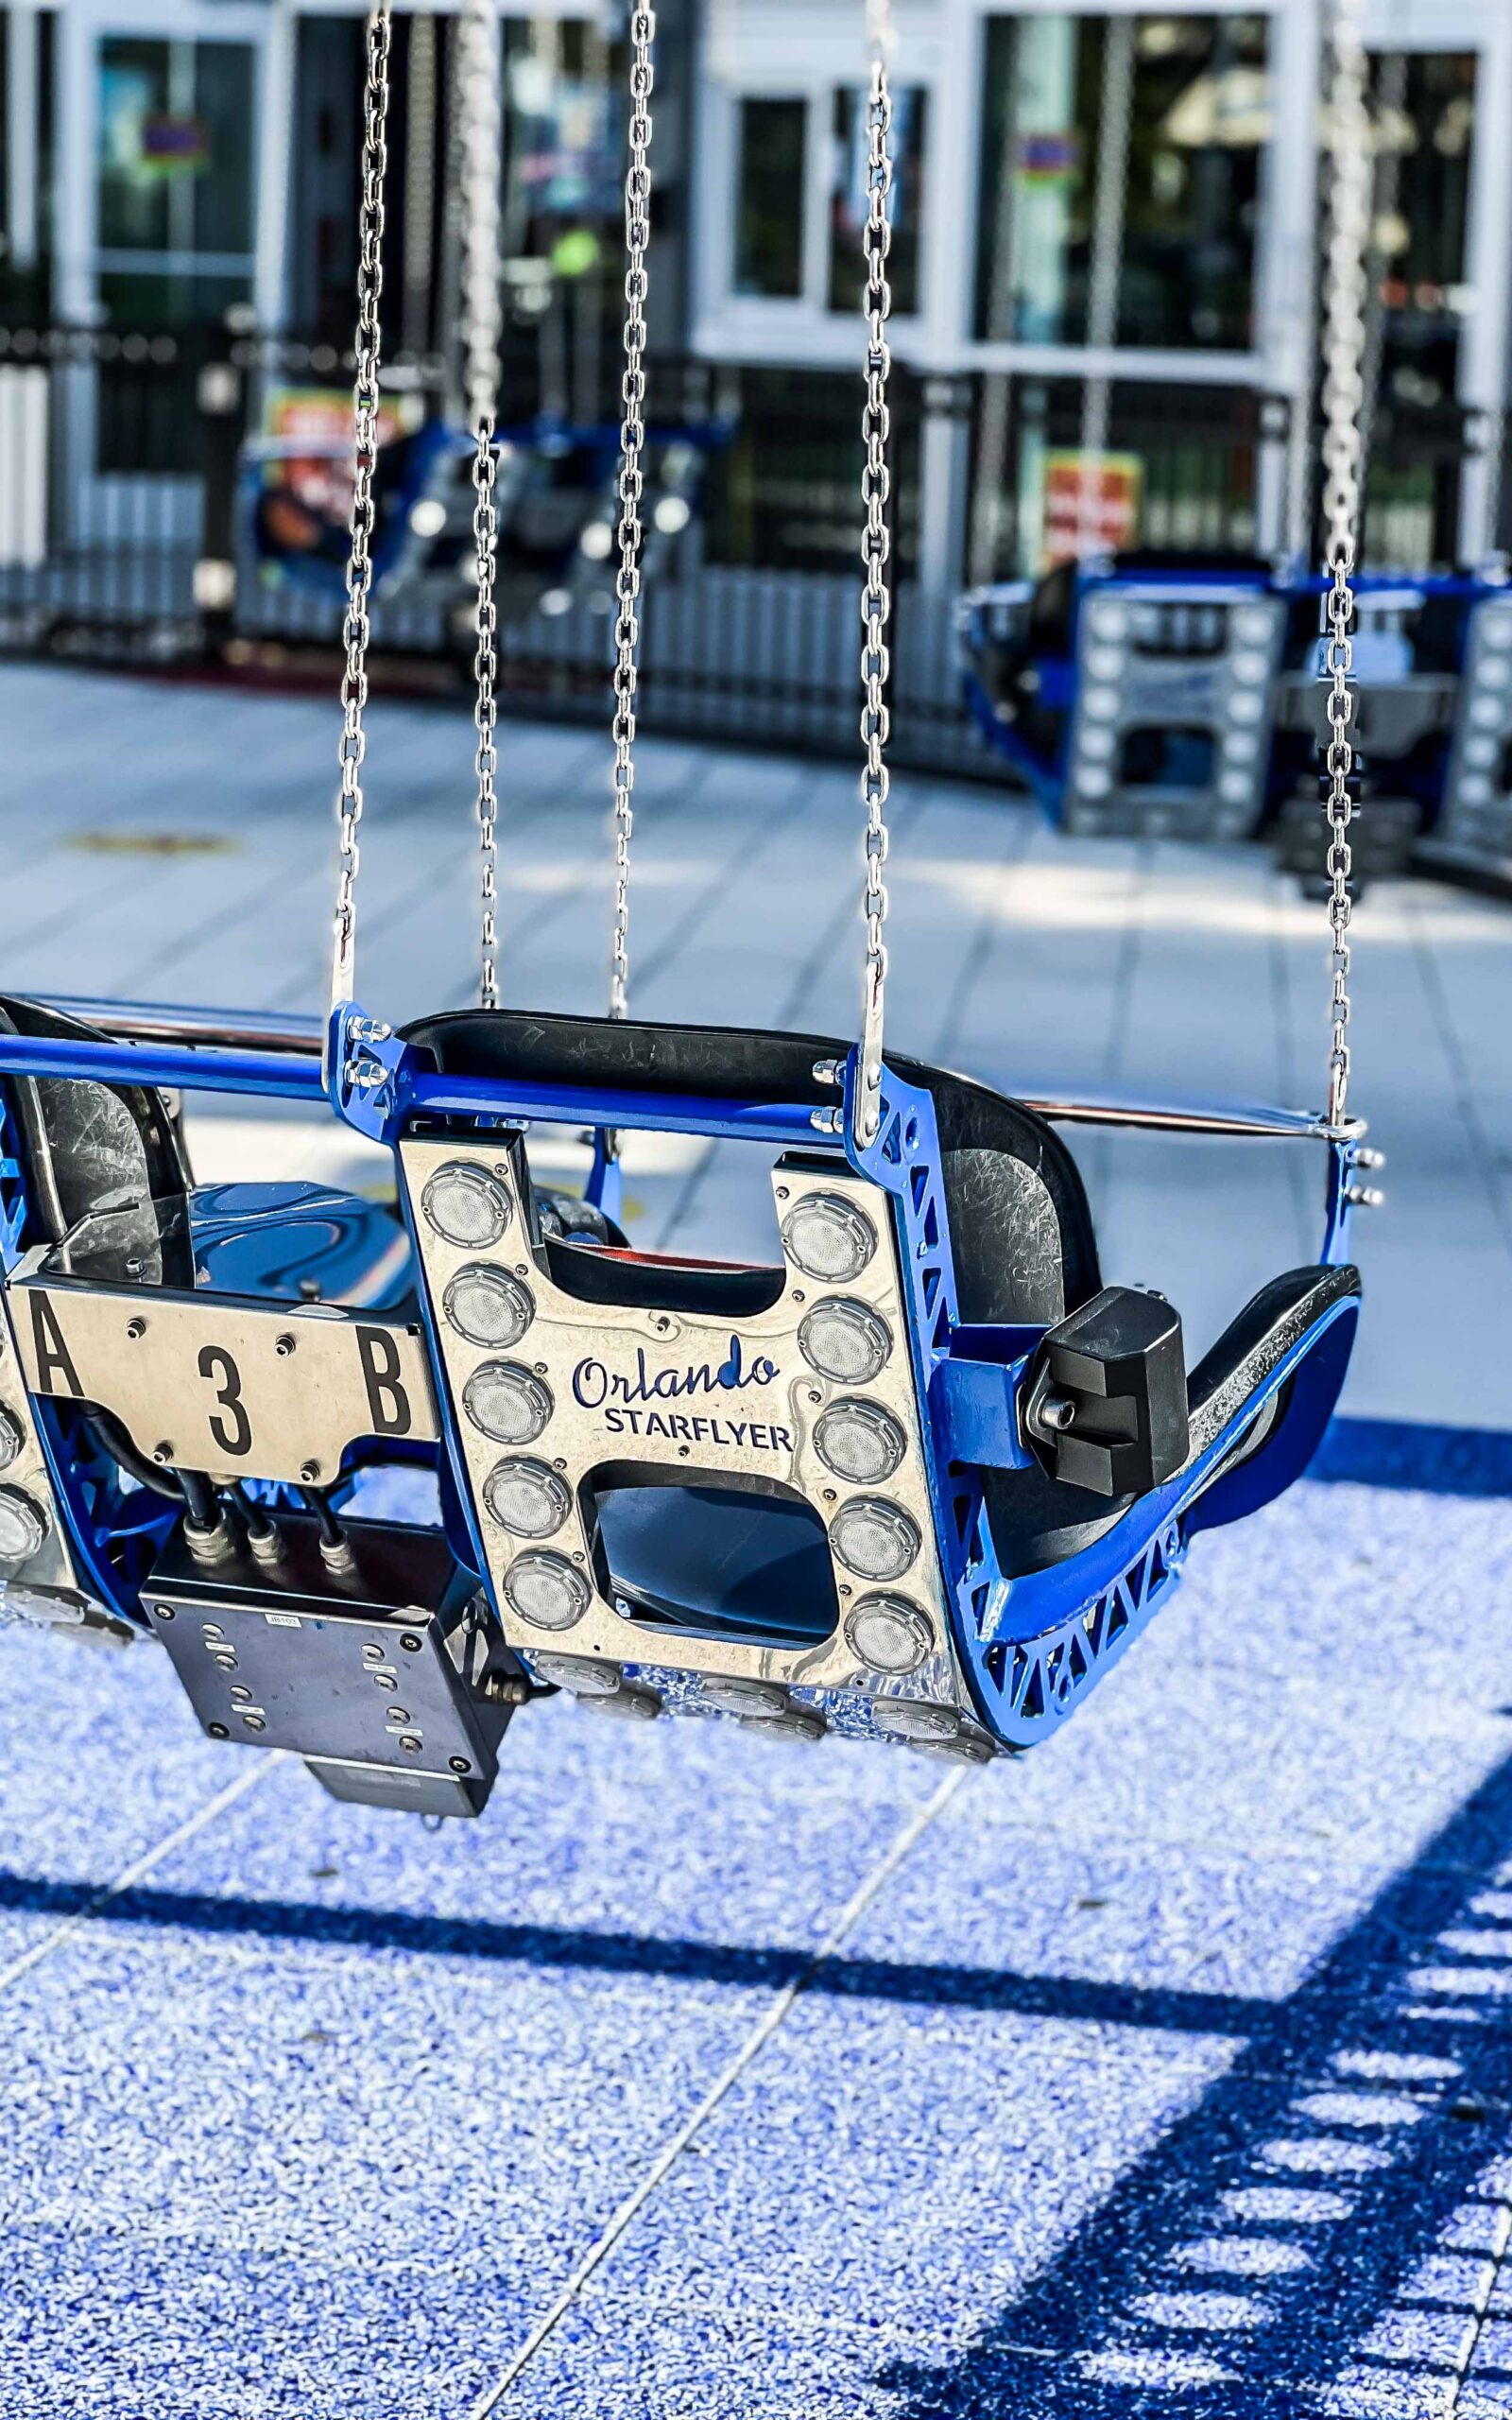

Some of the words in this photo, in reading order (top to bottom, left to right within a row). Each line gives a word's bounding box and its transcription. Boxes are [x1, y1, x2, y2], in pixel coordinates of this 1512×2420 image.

[28, 1289, 85, 1397] A
[198, 1345, 252, 1456] 3
[355, 1325, 412, 1435] B
[572, 1334, 781, 1409] Orlando
[605, 1408, 794, 1452] STARFLYER
